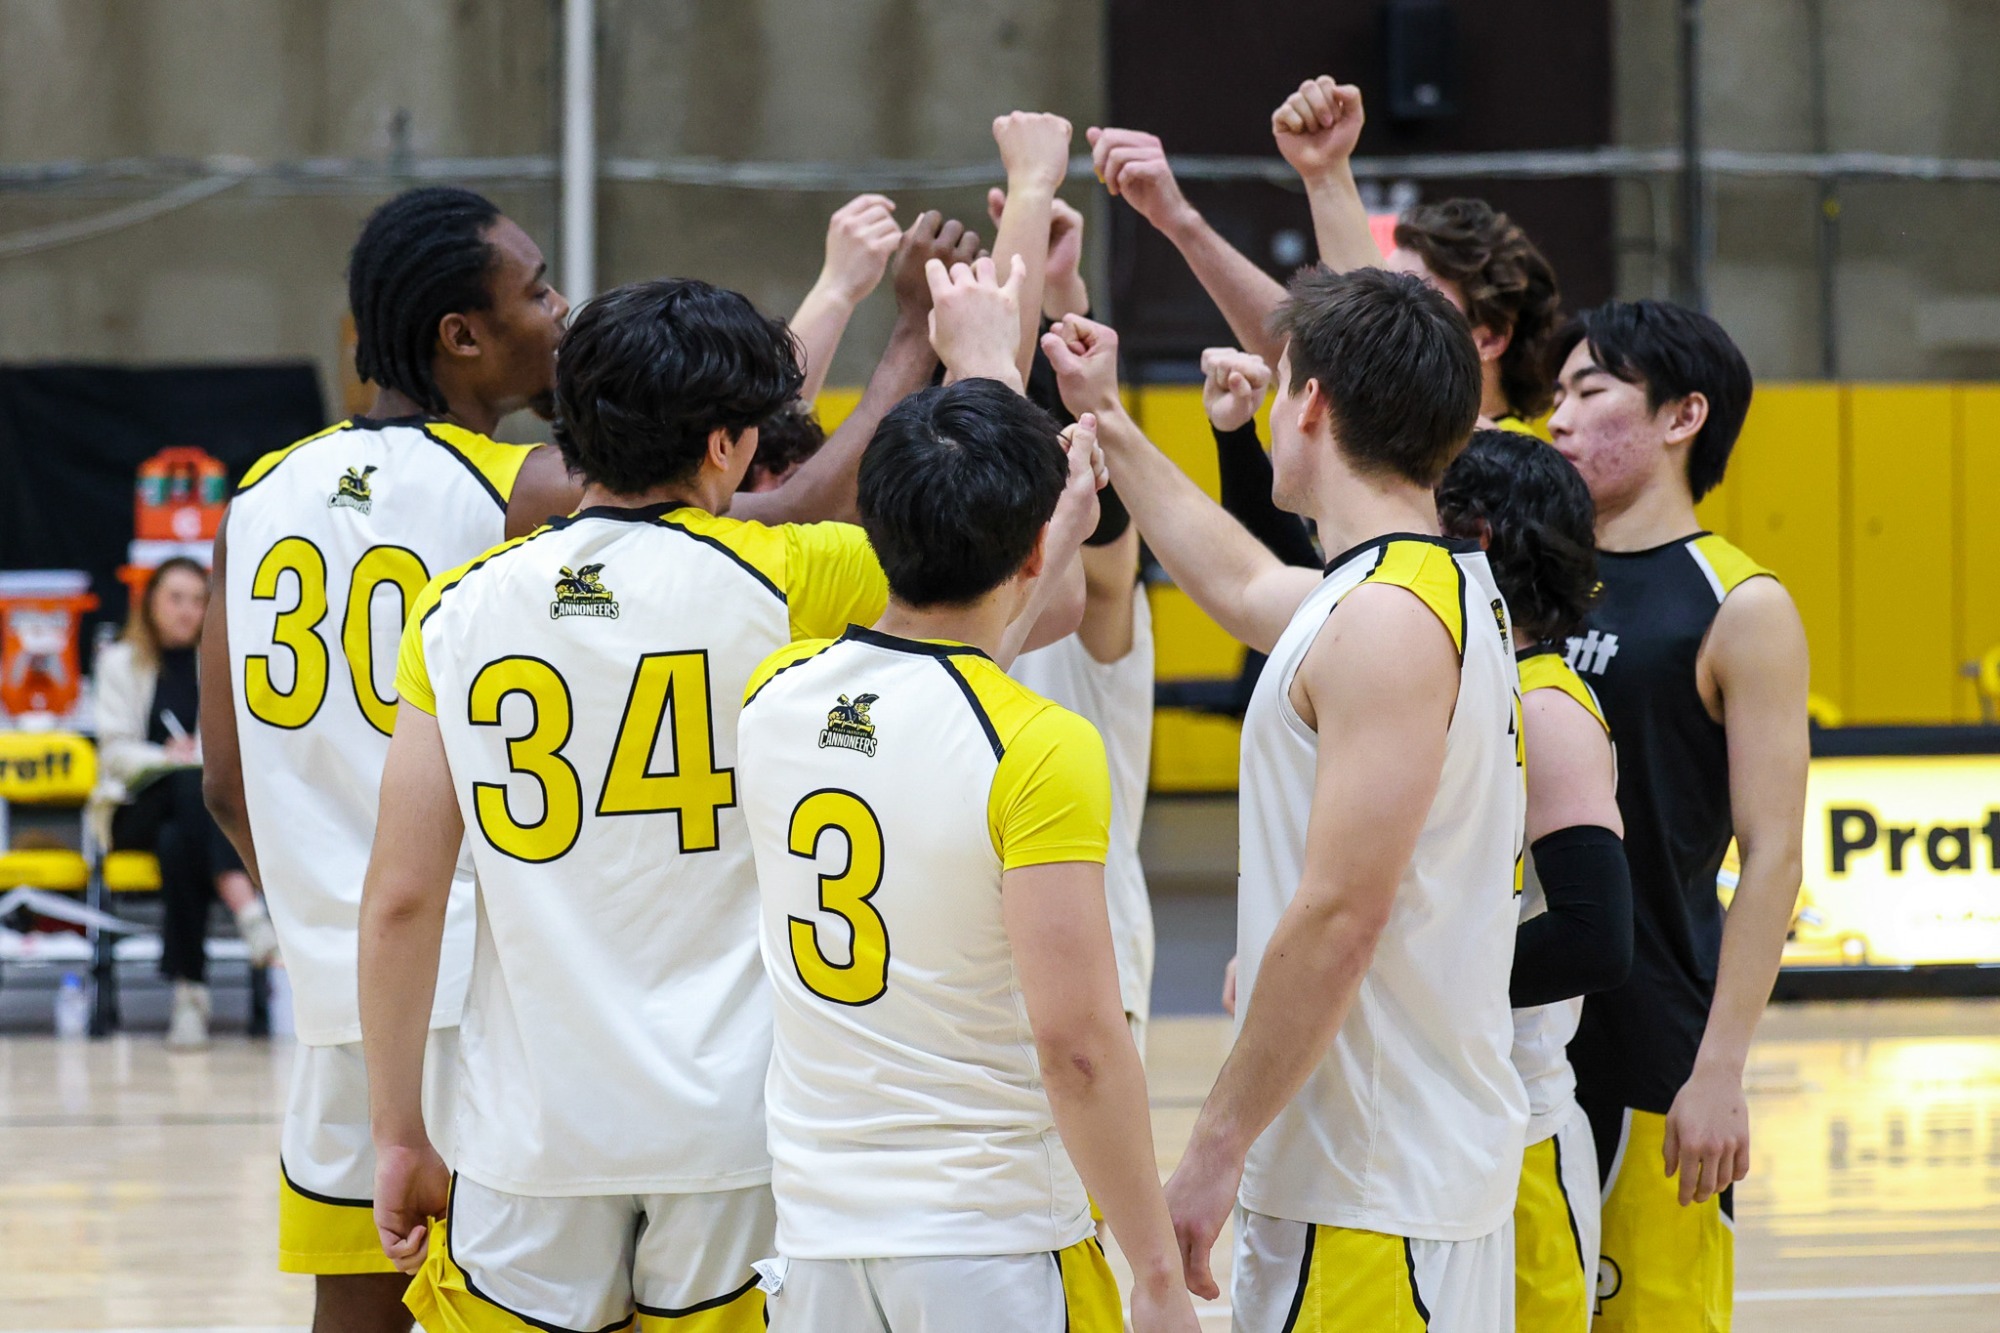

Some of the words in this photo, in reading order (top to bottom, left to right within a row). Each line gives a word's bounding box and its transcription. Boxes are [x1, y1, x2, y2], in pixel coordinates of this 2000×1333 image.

[244, 535, 431, 738] 30
[550, 602, 620, 620] CANNONEERS
[467, 648, 737, 864] 34
[818, 729, 878, 758] CANNONEERS
[787, 787, 891, 1007] 3
